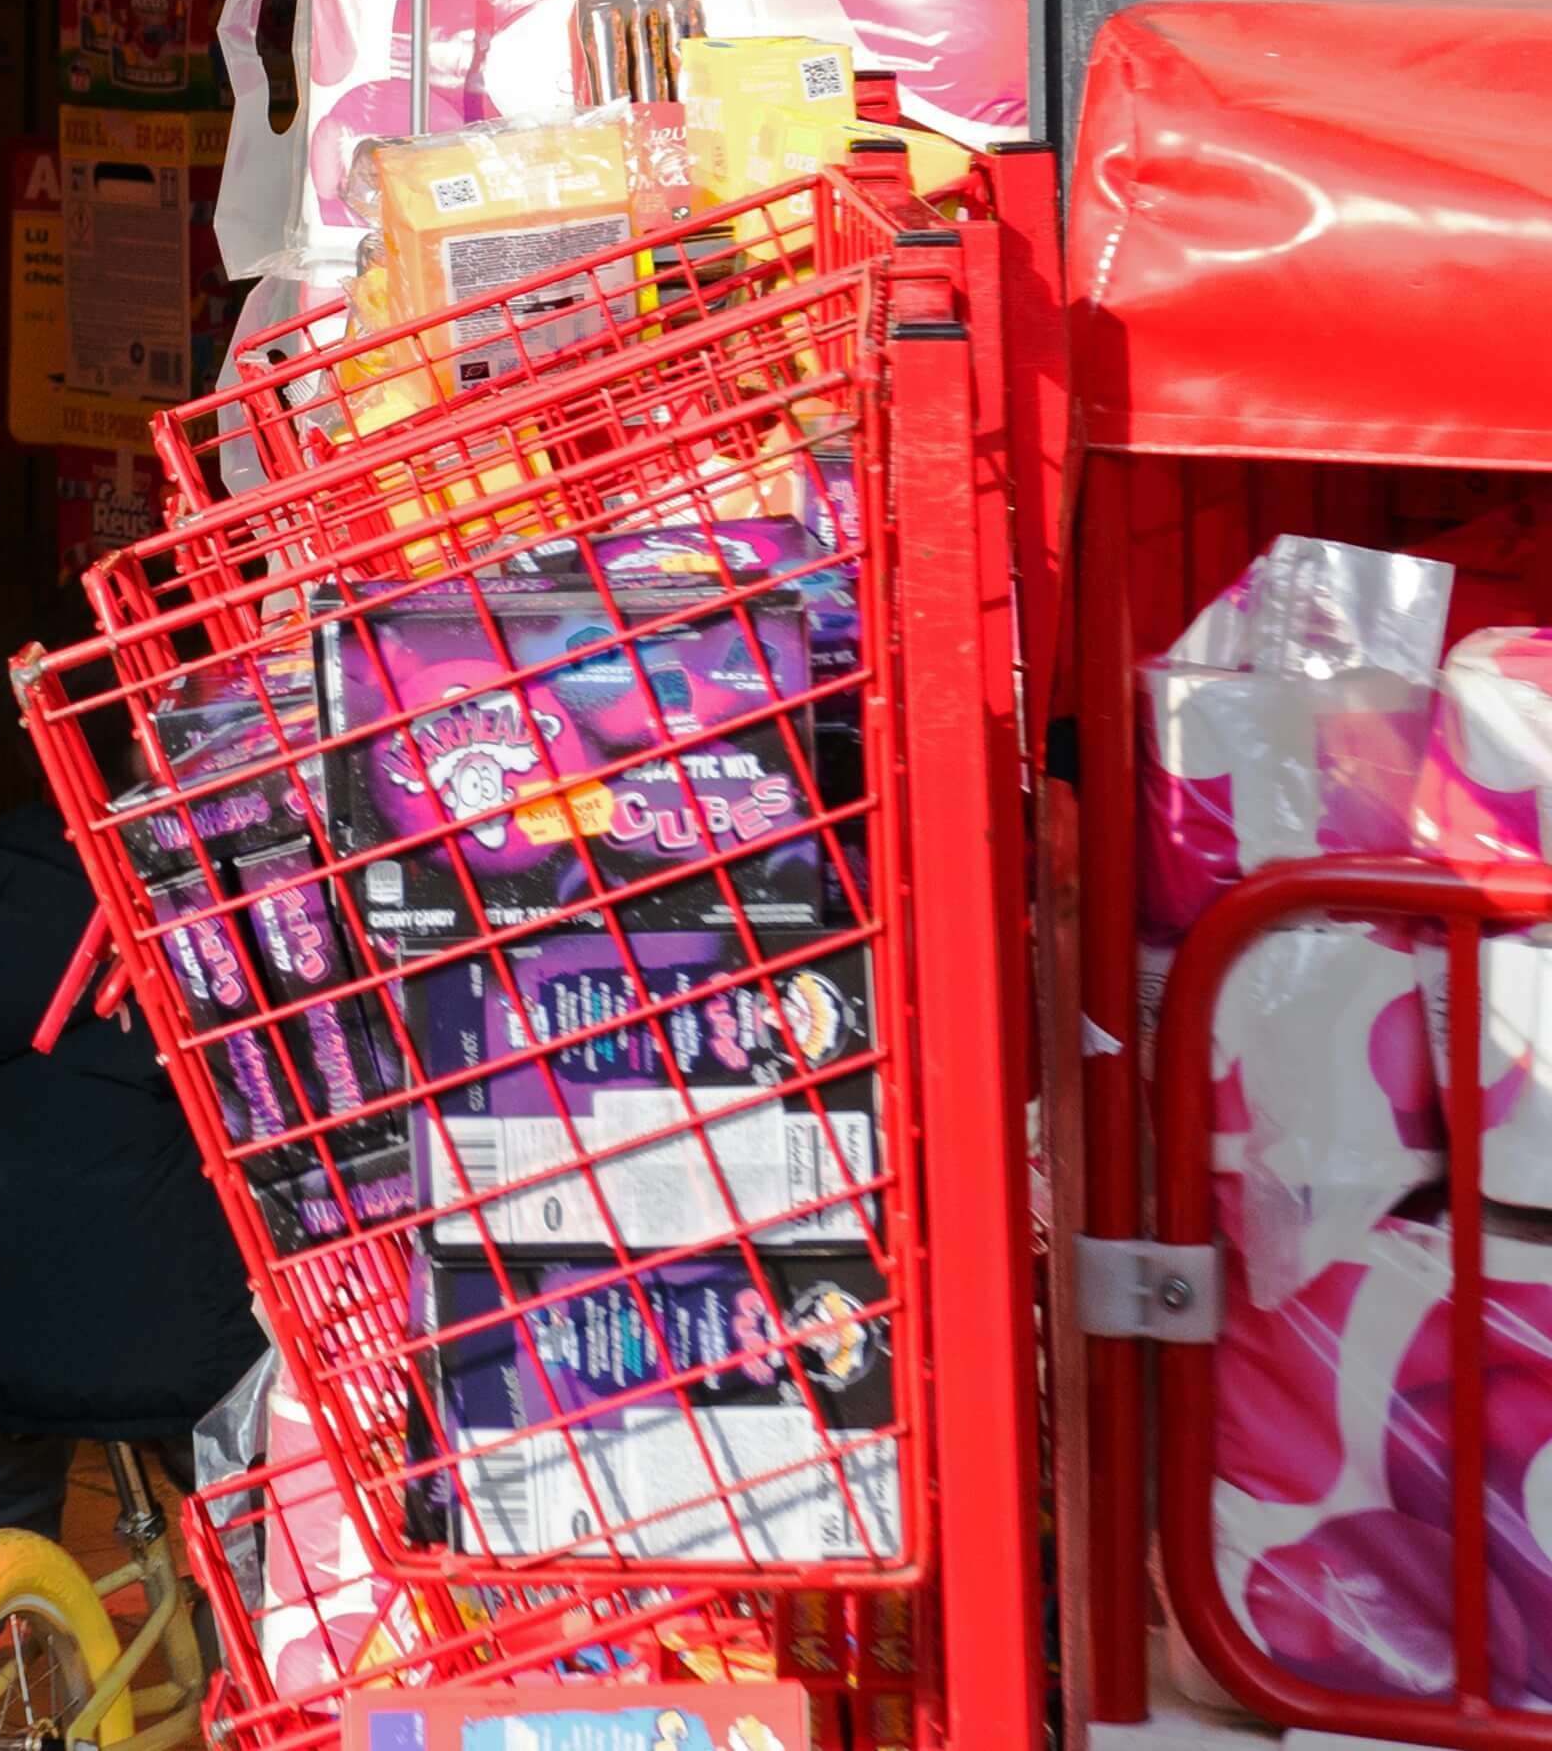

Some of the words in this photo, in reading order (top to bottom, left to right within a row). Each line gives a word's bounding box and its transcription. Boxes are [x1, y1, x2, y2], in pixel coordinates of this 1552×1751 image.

[721, 753, 767, 779] MIX
[608, 775, 792, 852] CUBES
[368, 910, 412, 928] CHEWY
[415, 909, 456, 927] CANDY
